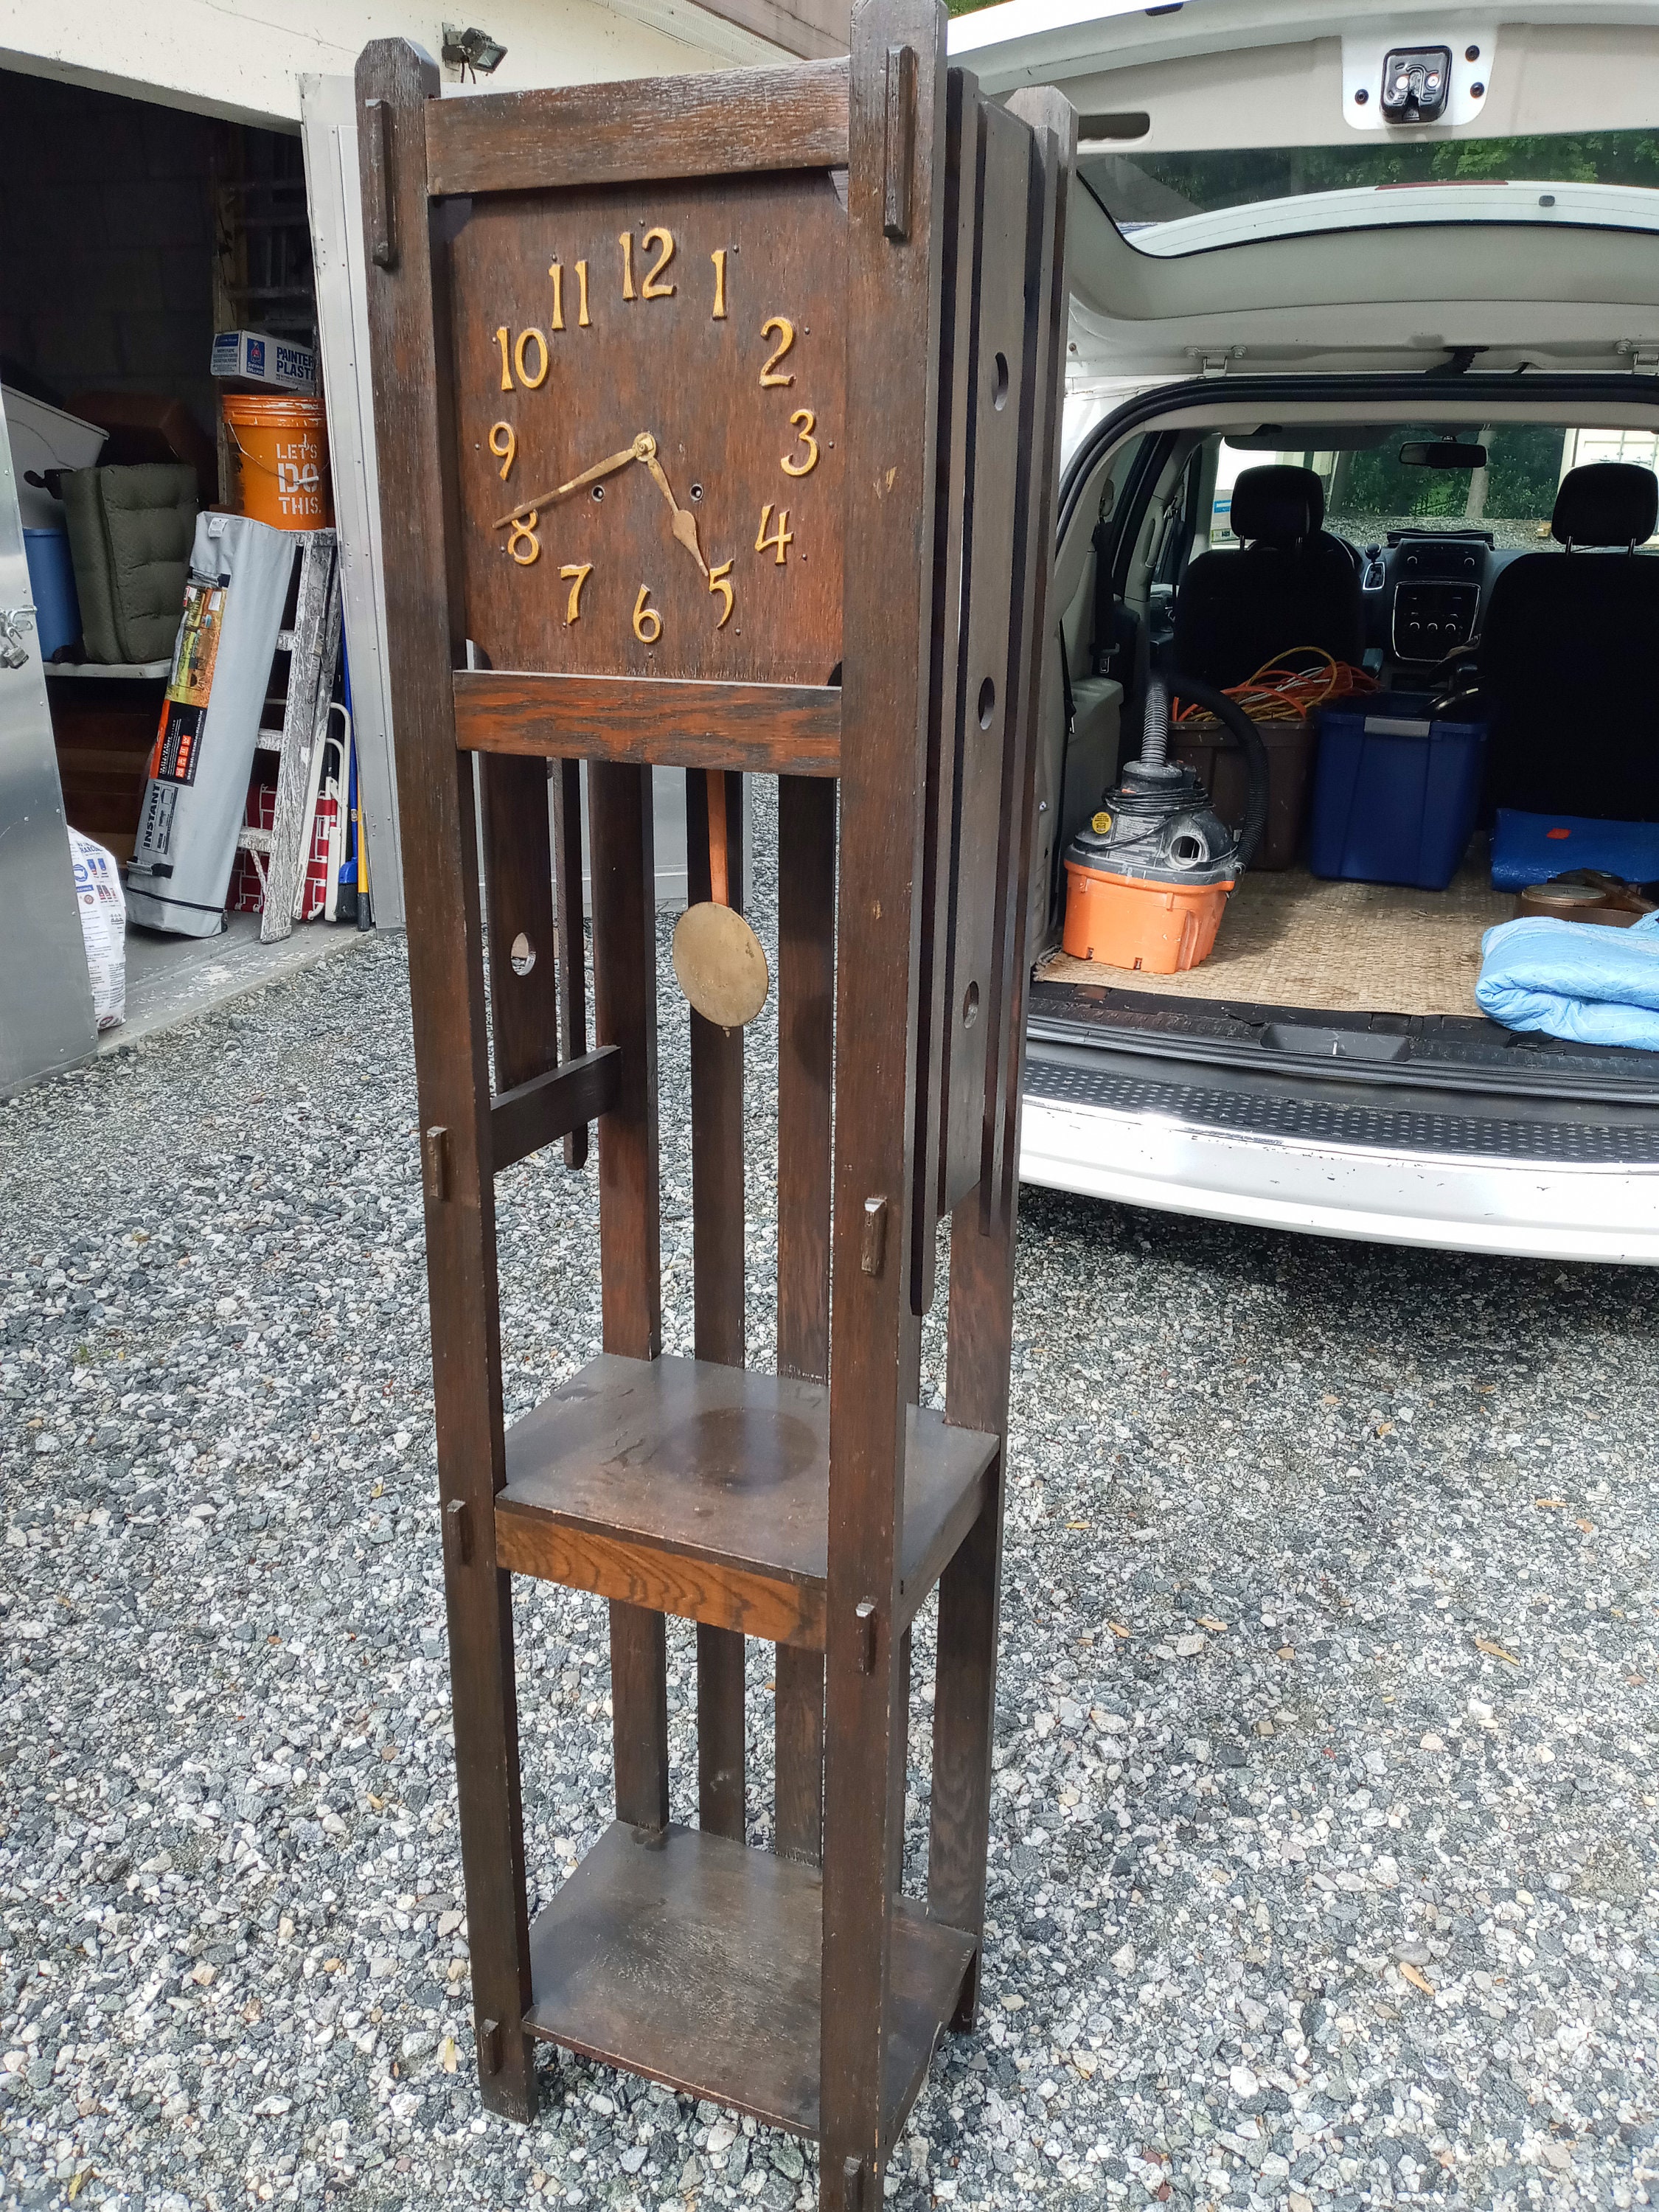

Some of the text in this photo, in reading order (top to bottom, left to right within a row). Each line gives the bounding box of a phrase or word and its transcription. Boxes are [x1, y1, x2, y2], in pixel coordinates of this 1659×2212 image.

[549, 260, 591, 330] 11
[619, 228, 676, 300] 12
[710, 249, 727, 319] 1
[496, 326, 549, 391] 10
[759, 316, 796, 387] 2
[276, 443, 318, 459] LET'S
[488, 421, 517, 480] 9
[780, 408, 818, 476] 3
[277, 463, 318, 493] DO
[278, 496, 321, 515] THIS.
[507, 509, 540, 565] 8
[754, 504, 794, 564] 4
[557, 563, 594, 625] 7
[632, 583, 662, 643] 6
[709, 558, 734, 630] 5
[143, 784, 161, 849] INSTANT
